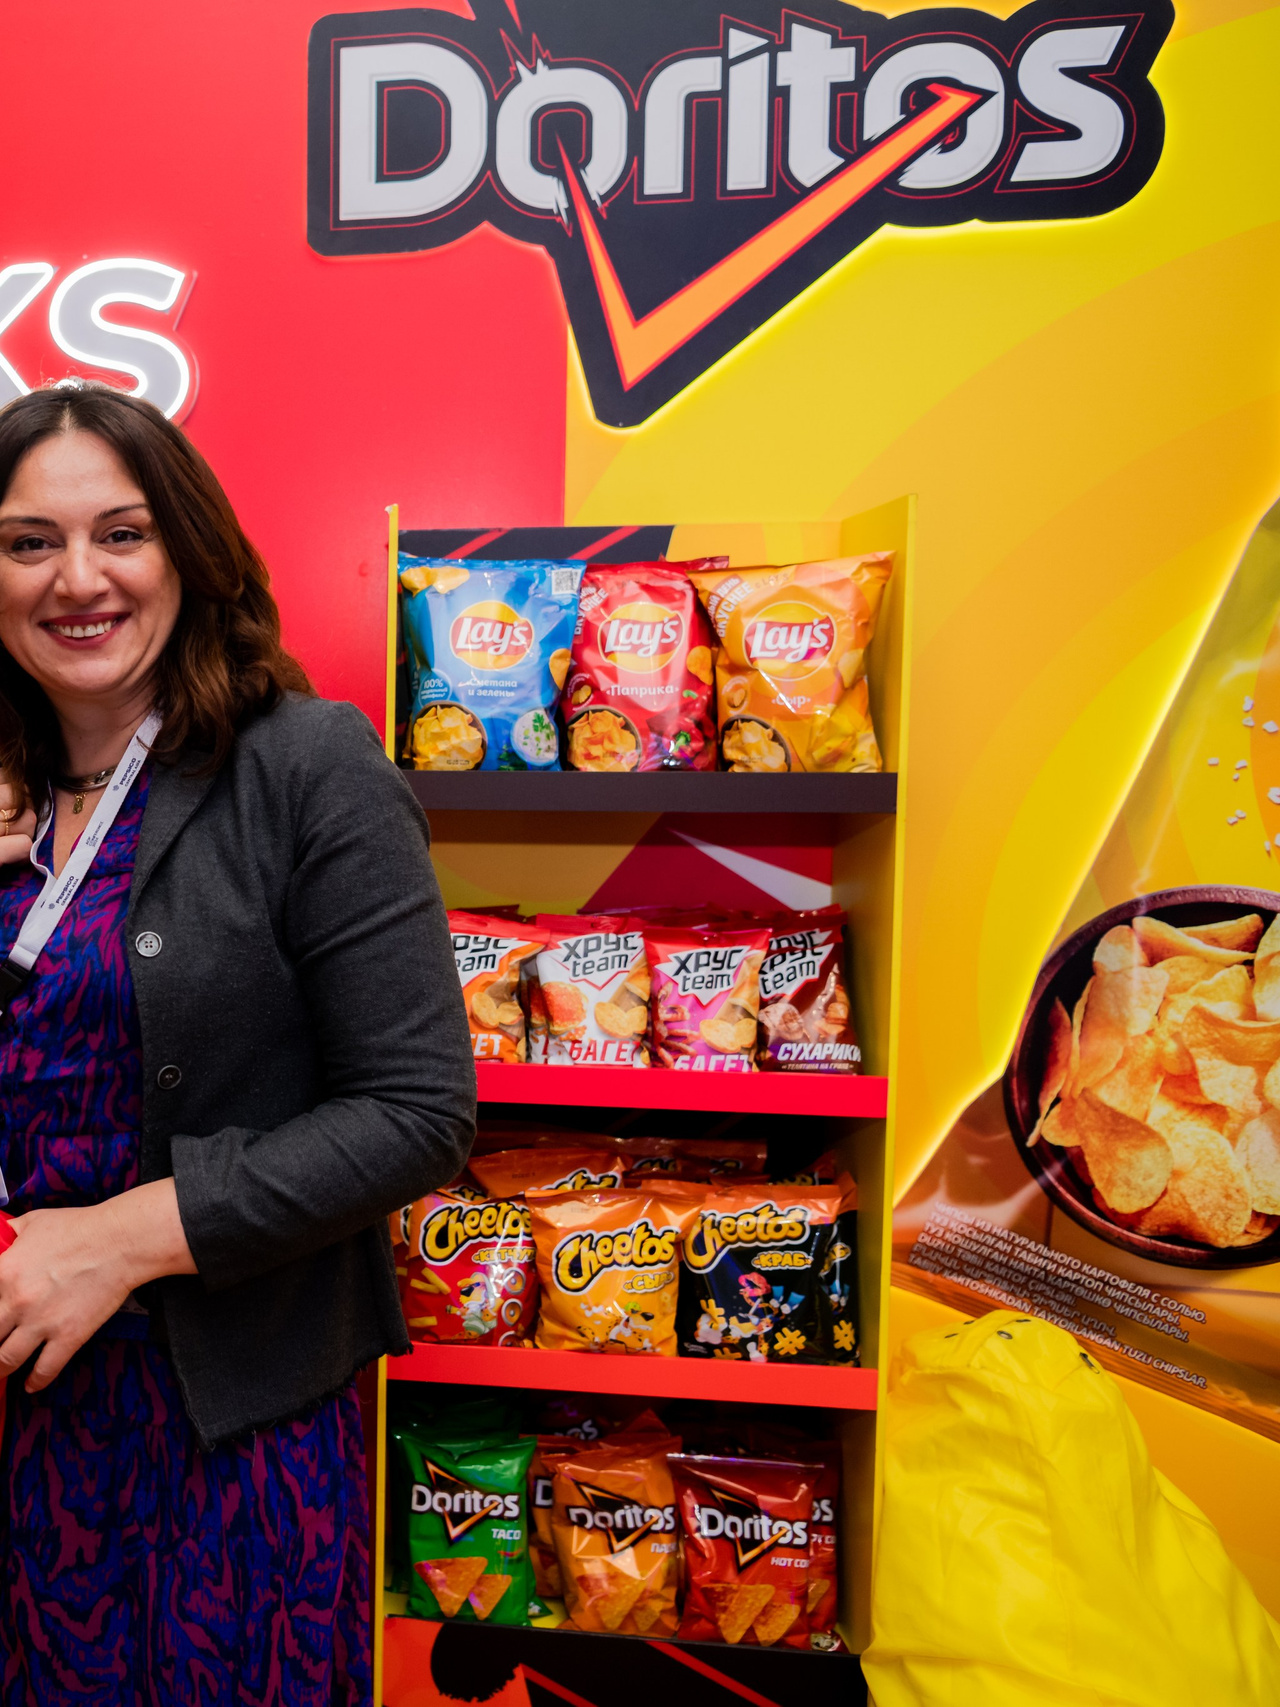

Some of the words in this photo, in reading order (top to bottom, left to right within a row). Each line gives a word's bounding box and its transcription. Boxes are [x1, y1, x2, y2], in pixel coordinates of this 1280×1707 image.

[338, 22, 1126, 224] Doritos
[455, 617, 529, 655] Lay's
[605, 618, 679, 658] Lay's
[750, 618, 830, 663] Lay's
[466, 678, 518, 688] Сметана
[119, 758, 136, 786] PEPSICO
[55, 875, 74, 904] PEPSICO
[572, 954, 629, 977] team
[682, 972, 732, 992] team
[761, 960, 816, 995] team
[569, 1040, 640, 1061] БАГЕТ
[777, 1043, 861, 1062] СУХАРИКИ
[422, 1202, 532, 1261] Cheetos
[683, 1203, 808, 1272] Cheetos
[556, 1222, 676, 1293] Cheetos
[932, 1200, 975, 1226] ЧИПСЫ
[975, 1218, 992, 1233] ИЗ
[992, 1225, 1081, 1270] НАТУРАЛЬНОГО
[1080, 1262, 1150, 1299] КАРТОФЕЛЯ
[1149, 1291, 1160, 1303] С
[1159, 1295, 1208, 1323] СОЛЬЮ.
[984, 1260, 1028, 1285] KARTOF
[943, 1231, 1008, 1265] КОШУЛГАН
[1111, 1301, 1191, 1342] ЧИПСЫЛАРЫ.
[1056, 1265, 1104, 1292] КАРТОП
[1102, 1285, 1182, 1326] ЧИПСЫЛАРЫ.
[942, 1268, 1032, 1313] KARTOSHKADAN
[1030, 1306, 1121, 1352] TAYYORLANGAN
[1121, 1344, 1152, 1365] TUZLI
[1151, 1357, 1209, 1388] CHIPSLAR.
[412, 1484, 519, 1518] Doritos
[569, 1504, 675, 1531] Doritos
[491, 1528, 521, 1540] TACO
[700, 1507, 808, 1546] Doritos
[771, 1557, 793, 1567] HOT
